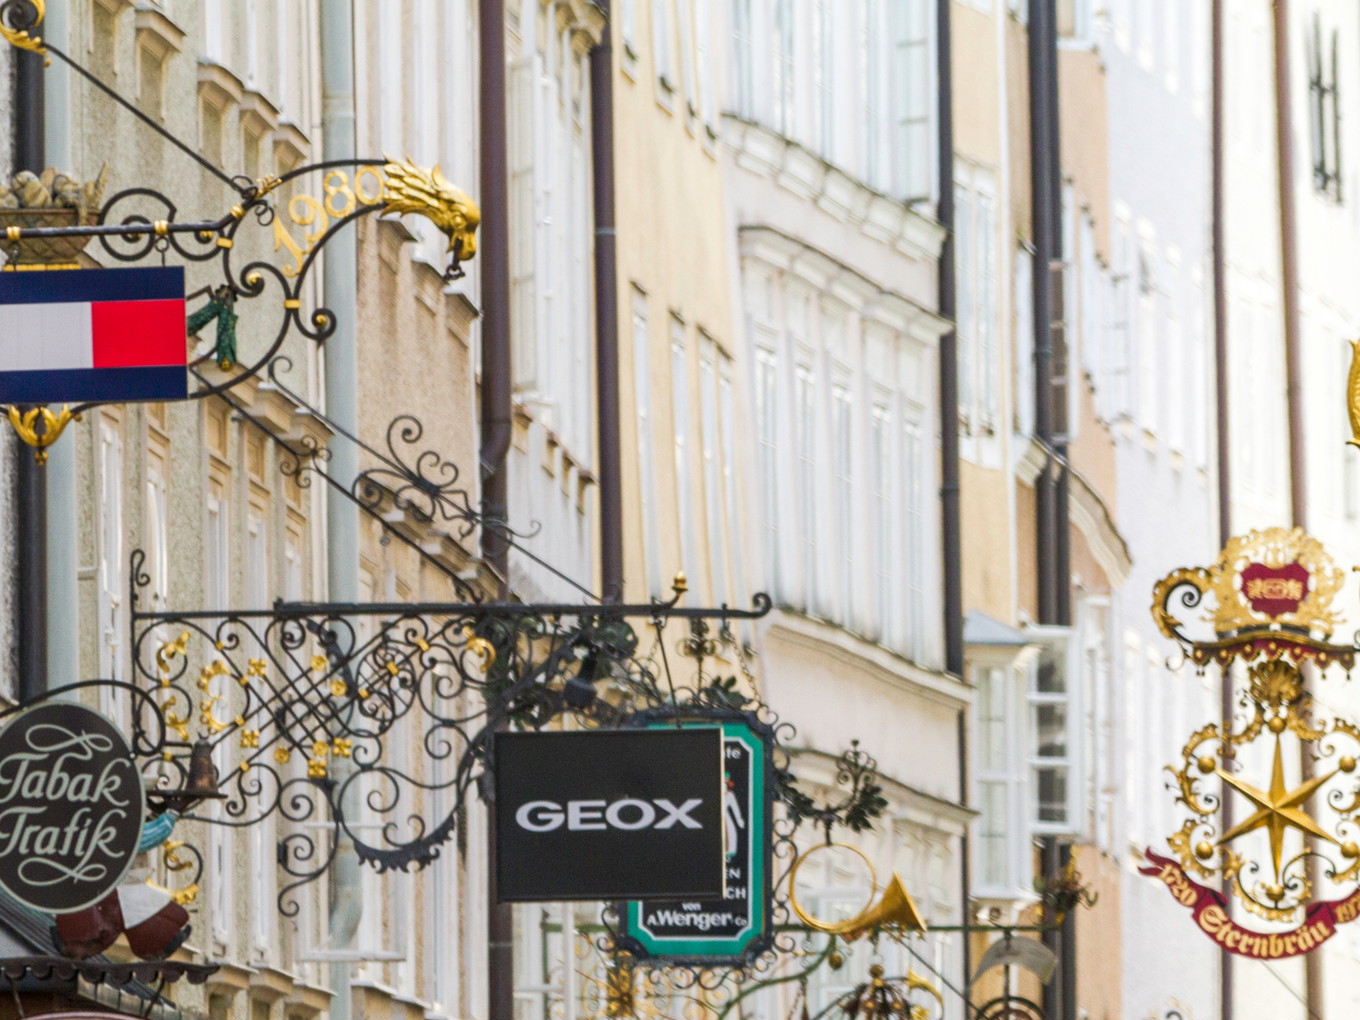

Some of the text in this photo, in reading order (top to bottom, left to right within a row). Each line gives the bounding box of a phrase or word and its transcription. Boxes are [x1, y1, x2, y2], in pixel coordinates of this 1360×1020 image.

[272, 165, 386, 277] 1980
[0, 738, 130, 807] Tabak
[0, 806, 127, 870] Trafik
[515, 799, 703, 832] GEOX
[1199, 905, 1330, 958] Sternbräu
